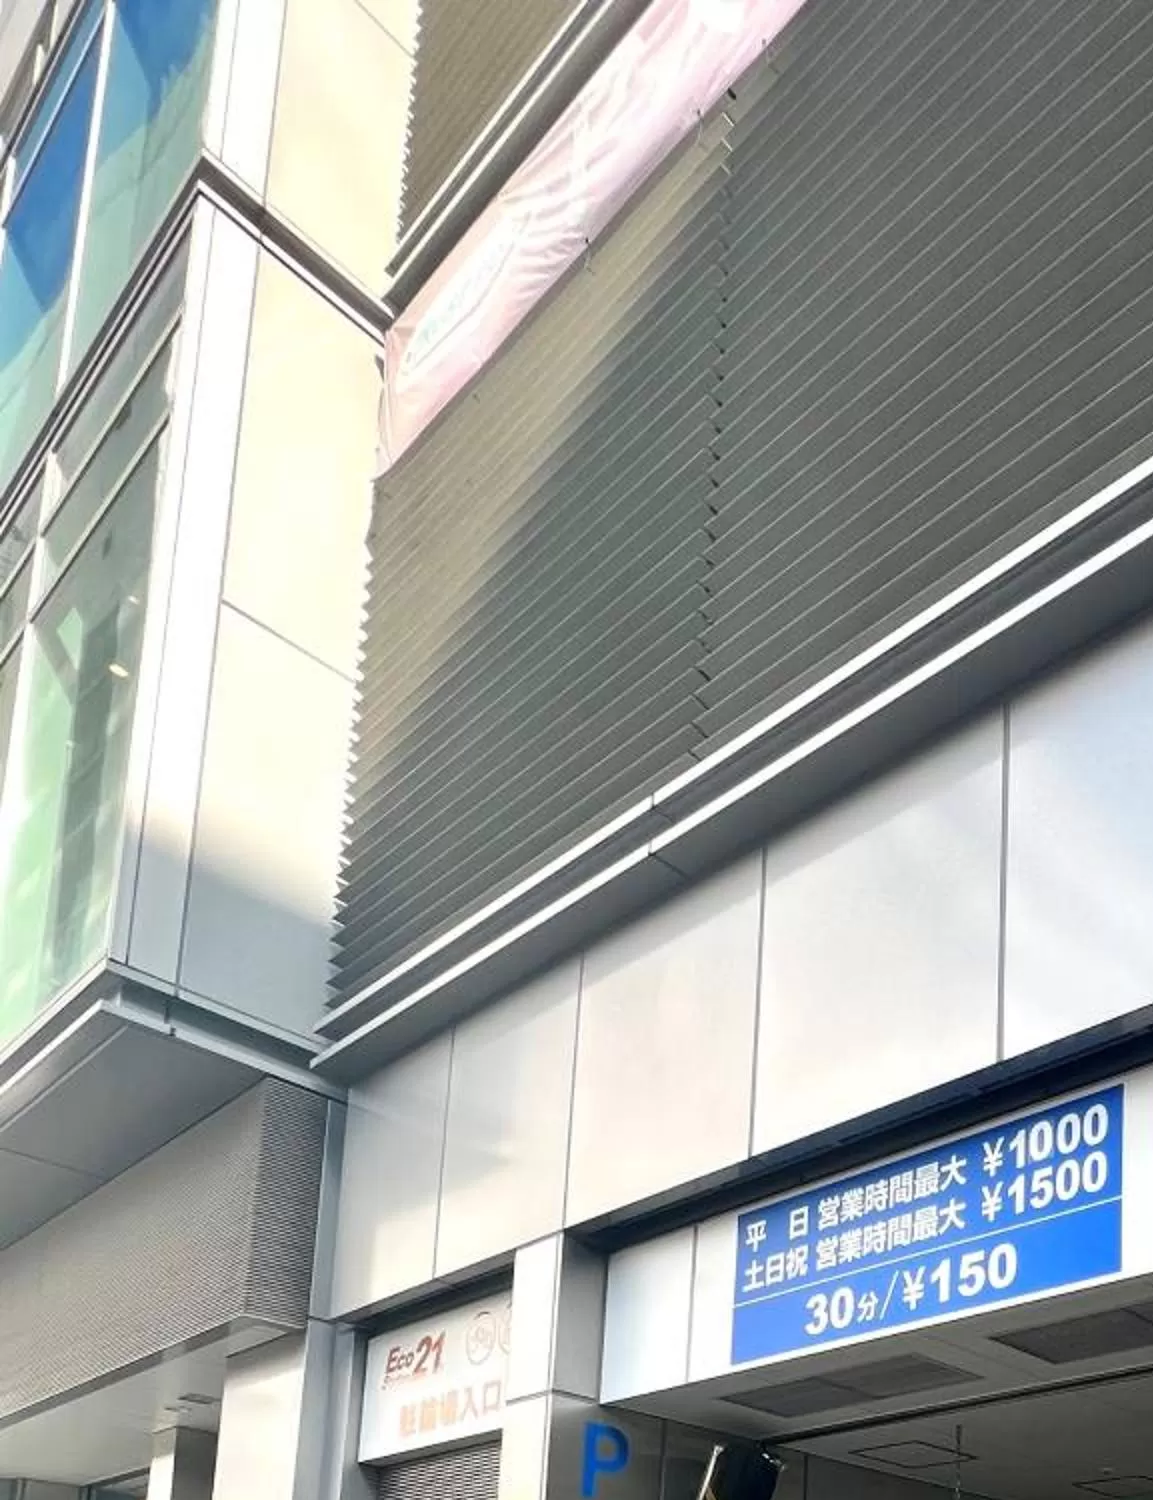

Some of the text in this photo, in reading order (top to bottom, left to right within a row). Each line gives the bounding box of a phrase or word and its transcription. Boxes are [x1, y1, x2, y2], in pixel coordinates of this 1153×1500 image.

[743, 1151, 1108, 1292] 土日祝 営業時間最大 ¥1500
[817, 1154, 967, 1230] 営業時間最大
[982, 1103, 1109, 1177] ¥1000
[580, 1421, 631, 1499] P
